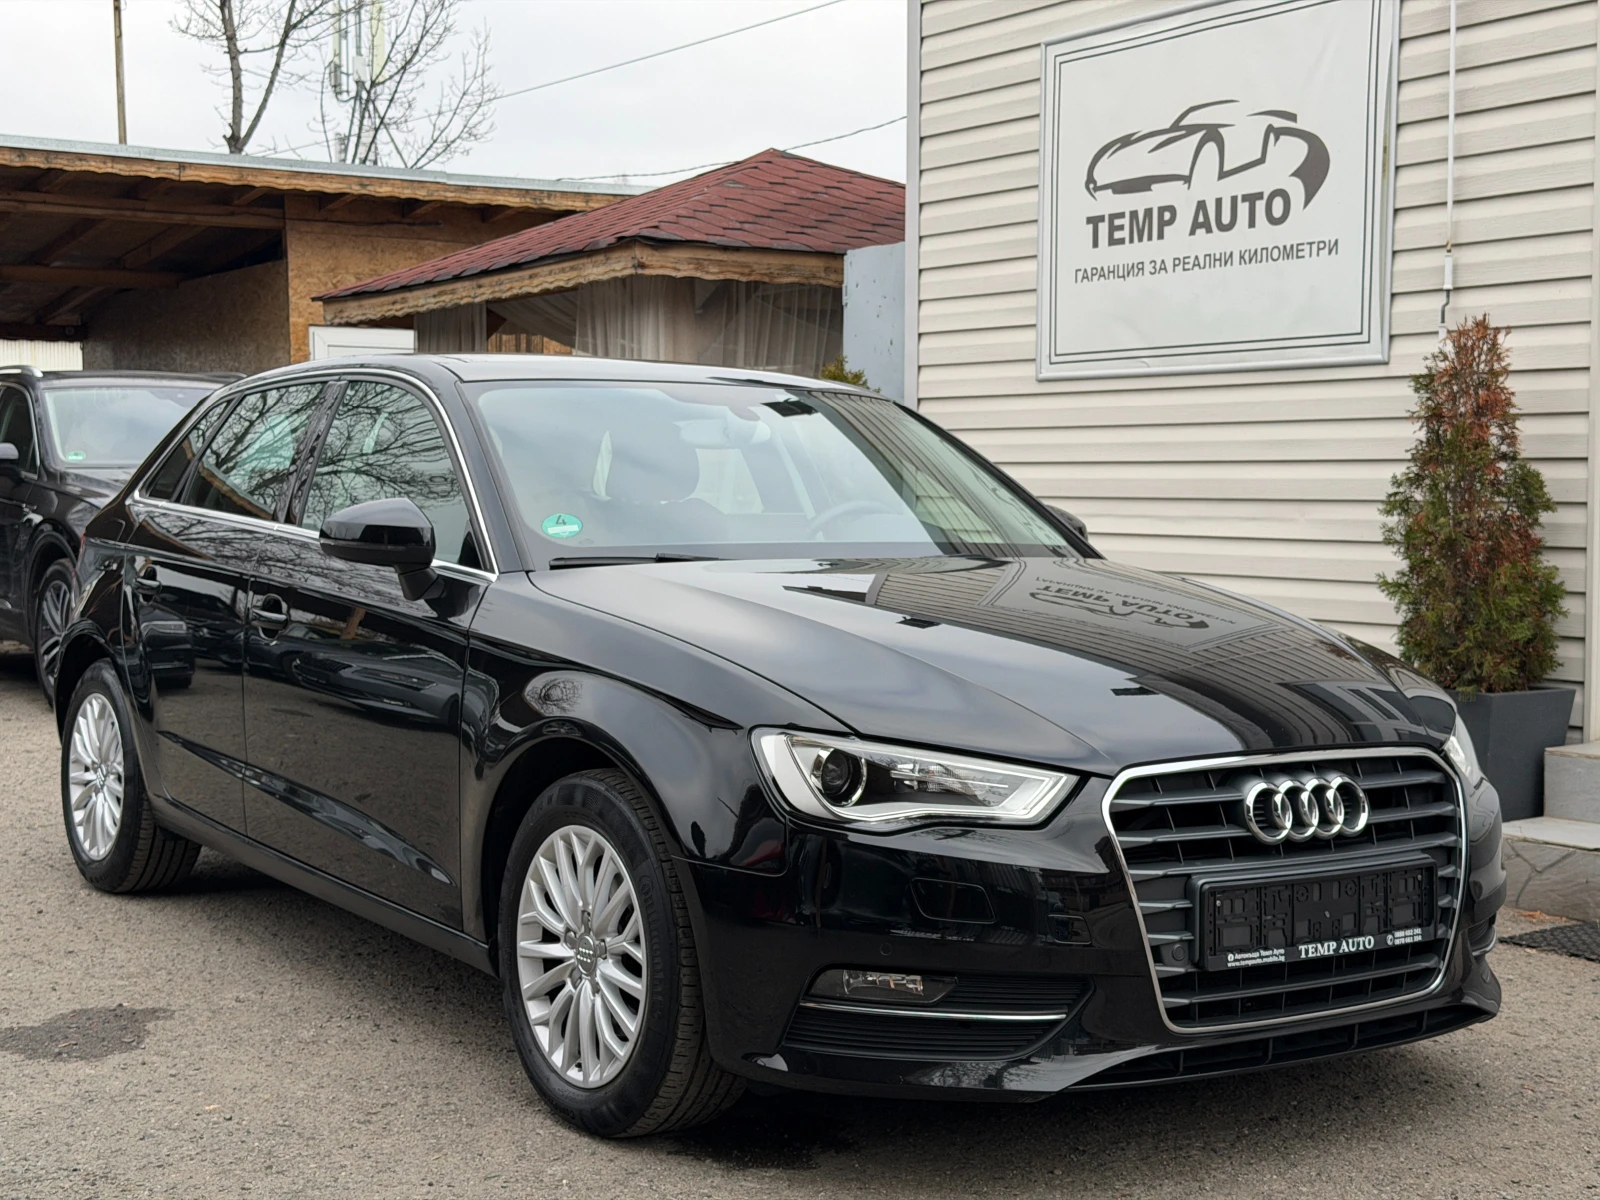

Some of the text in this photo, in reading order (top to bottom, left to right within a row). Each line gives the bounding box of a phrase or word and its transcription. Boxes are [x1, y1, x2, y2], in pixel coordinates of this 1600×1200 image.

[1086, 188, 1291, 249] TEMP AUTO
[1075, 238, 1339, 284] ГАРАНЦИЯ ЗА РЕАЛНИ КИЛОМЕТРИ
[555, 514, 567, 525] 4
[1299, 936, 1375, 958] TEMP AUTO
